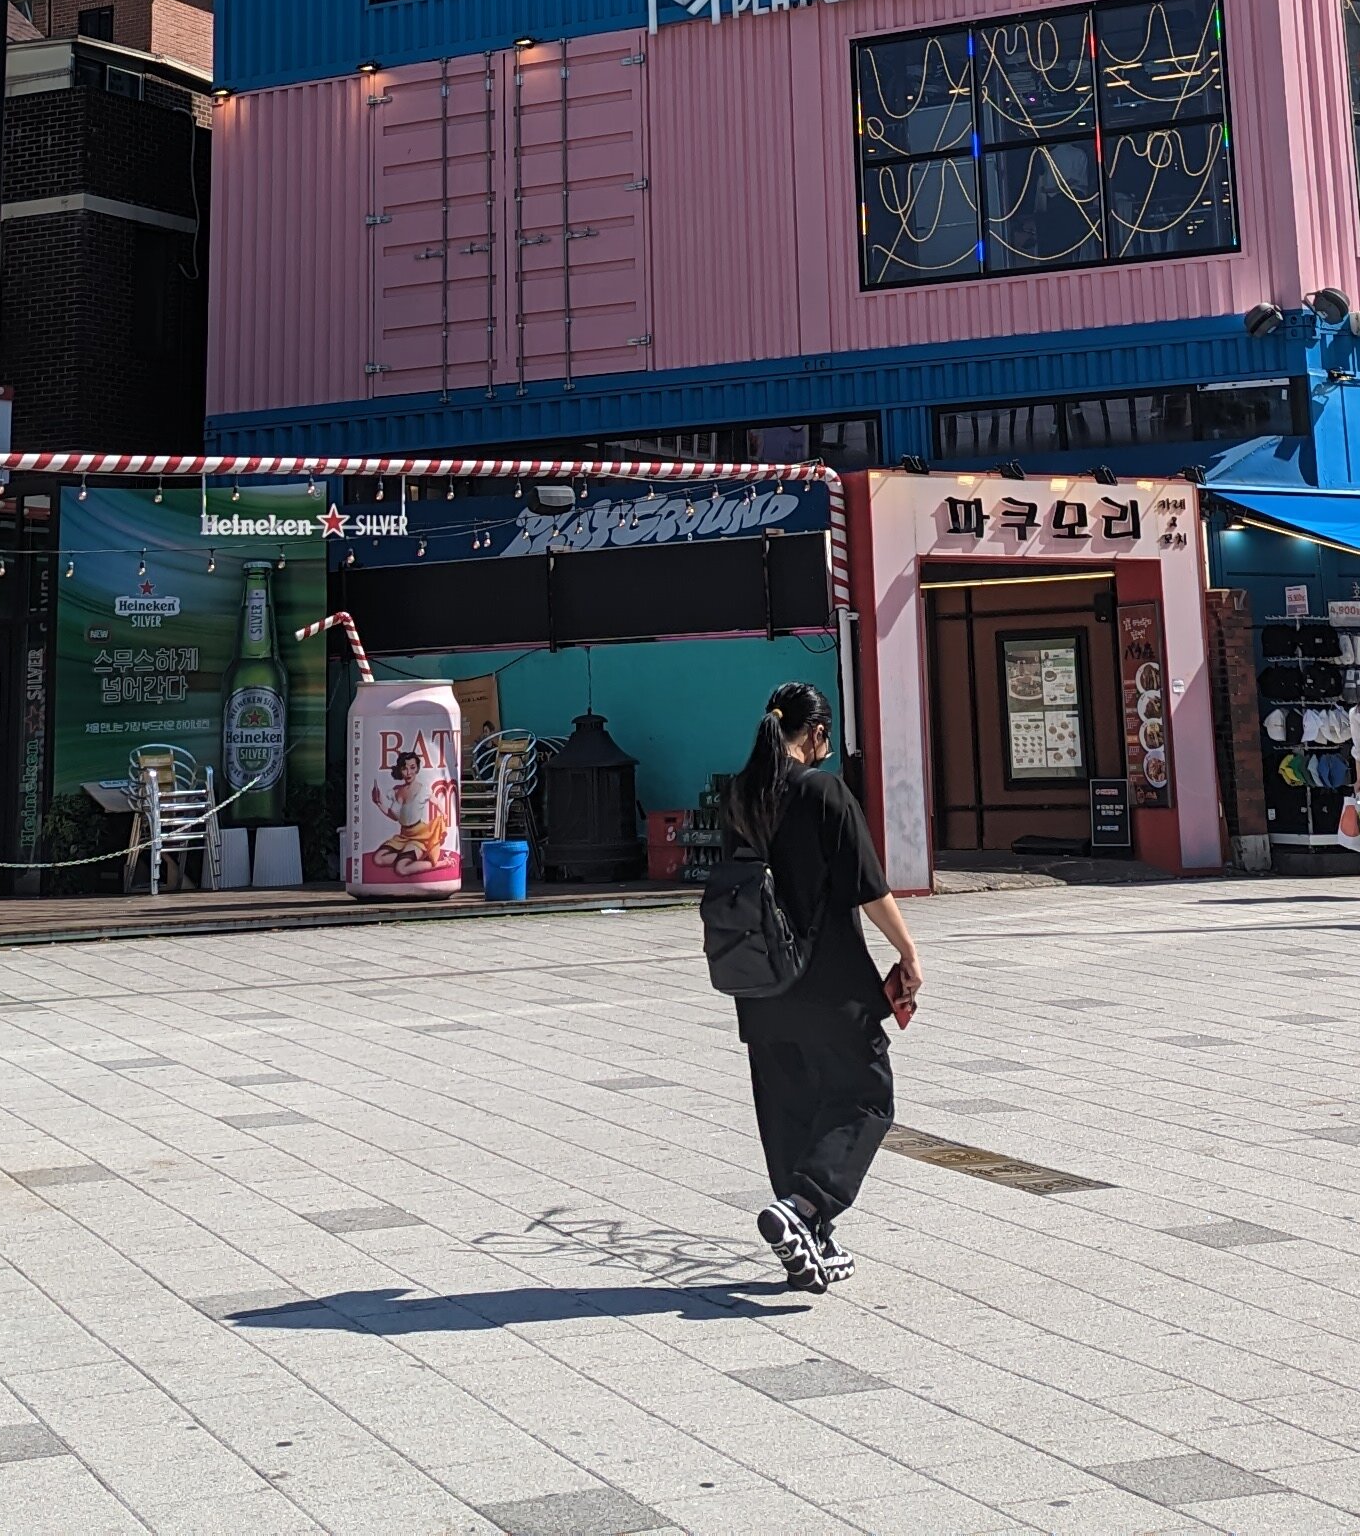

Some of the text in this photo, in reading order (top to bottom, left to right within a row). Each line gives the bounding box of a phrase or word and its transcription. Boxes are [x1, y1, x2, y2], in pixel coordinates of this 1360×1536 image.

[1156, 497, 1186, 512] 카레
[201, 514, 409, 536] Heineken SILVER
[944, 496, 1142, 541] 파쿠모리
[118, 599, 177, 612] Heineken
[131, 615, 162, 627] SILVER
[250, 603, 263, 635] SILVER
[93, 647, 199, 672] 스무스하게
[26, 648, 44, 701] SILVER
[102, 675, 189, 703] 넘어간다
[226, 730, 283, 744] Heineken
[240, 748, 268, 760] SILVER
